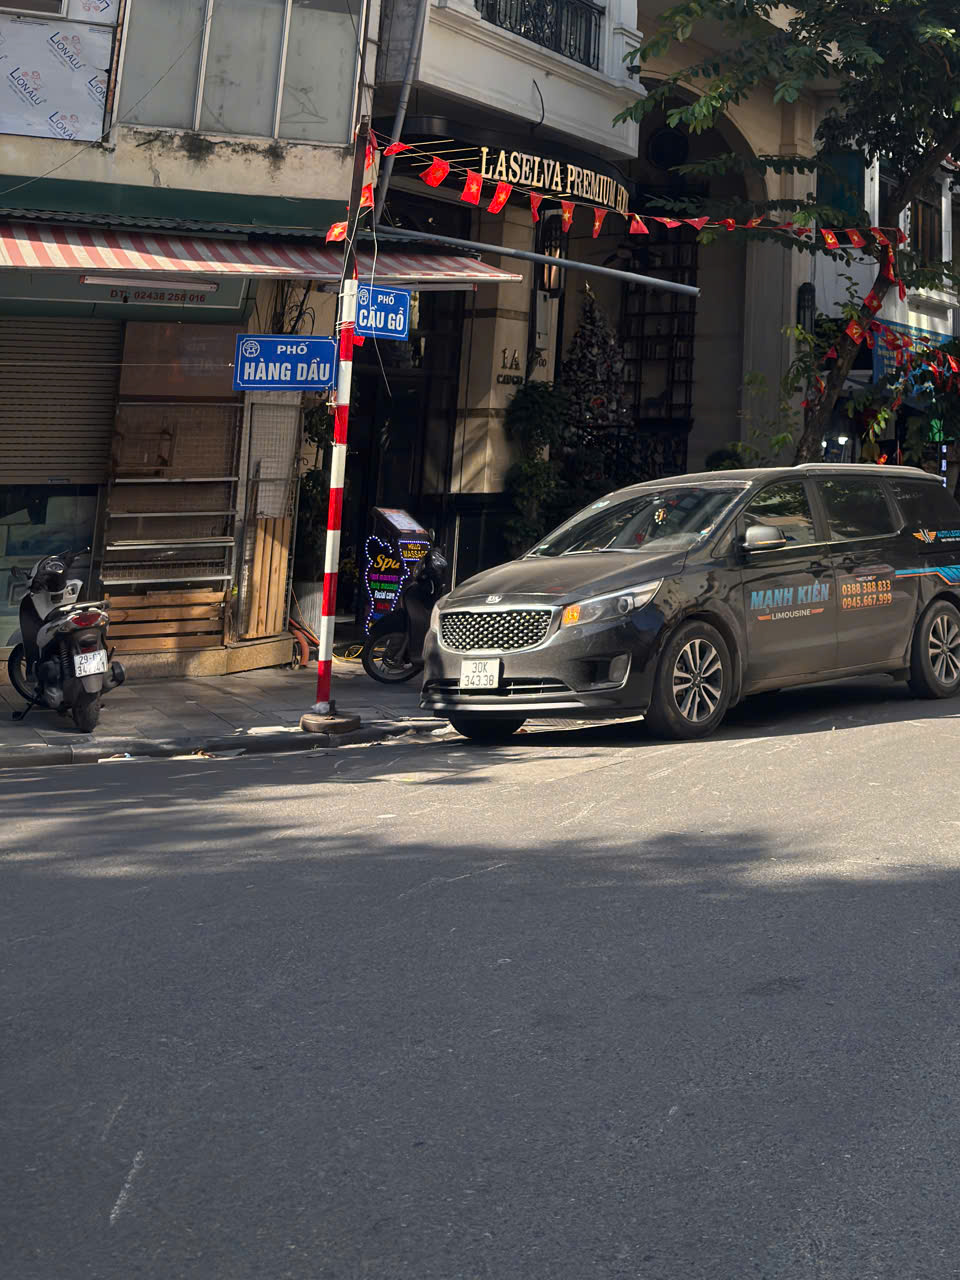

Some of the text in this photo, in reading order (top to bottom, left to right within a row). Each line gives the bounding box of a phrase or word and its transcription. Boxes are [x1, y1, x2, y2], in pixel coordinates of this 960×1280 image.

[49, 31, 82, 70] LIONALU
[9, 66, 42, 106] LIONALU
[480, 146, 562, 192] LASELVA
[566, 163, 616, 207] PREMIUM
[377, 293, 396, 305] PHỐ
[358, 305, 405, 331] CẦU GỖ
[276, 342, 309, 355] PHỐ
[244, 358, 330, 381] HÀNG DẦU
[797, 579, 830, 604] KIÊN
[842, 580, 891, 594] 0388 388 833
[842, 593, 892, 609] 0945.667.999
[771, 608, 811, 620] LIMOUSINE
[472, 662, 488, 673] 30K
[464, 674, 495, 687] 343.38
